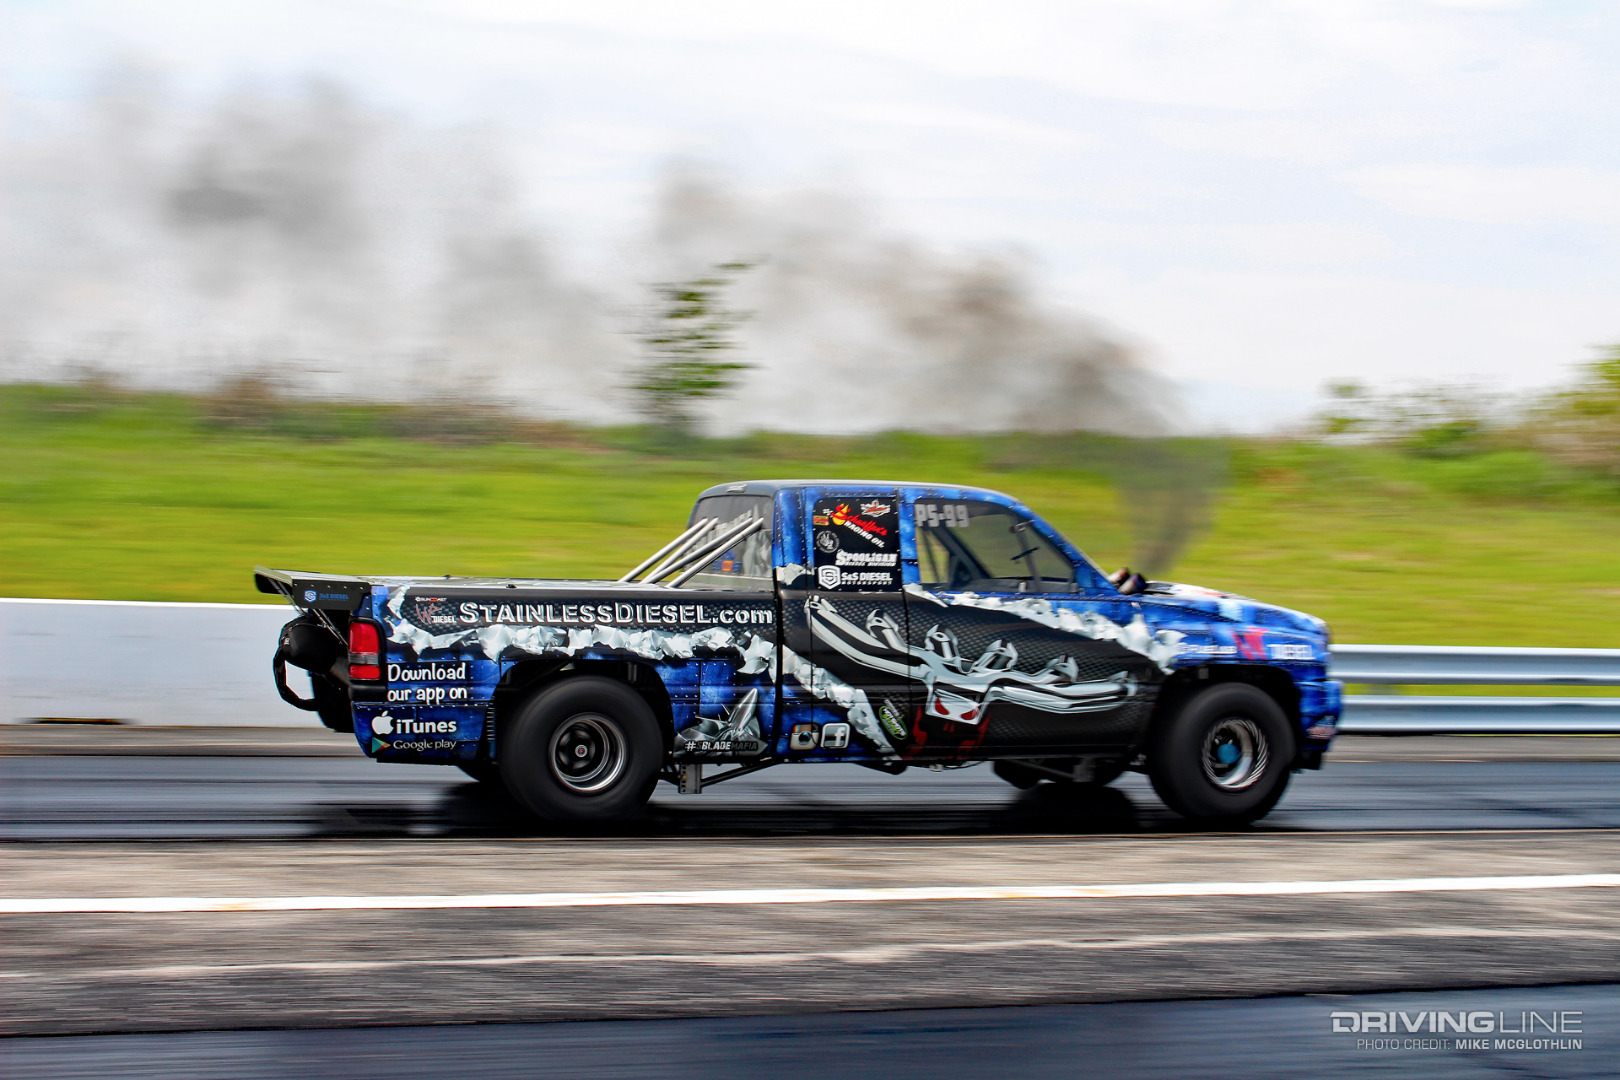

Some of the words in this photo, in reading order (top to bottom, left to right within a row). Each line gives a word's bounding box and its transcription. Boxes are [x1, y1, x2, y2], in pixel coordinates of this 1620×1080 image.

[843, 520, 874, 540] RACING
[871, 537, 885, 549] OIL
[841, 572, 859, 581] S&S
[860, 572, 893, 581] DIESEL
[430, 615, 457, 624] DIESEL
[459, 602, 773, 624] STAINLESSDIESEL.com
[387, 662, 466, 682] Download
[387, 688, 412, 702] our
[416, 687, 445, 705] app
[449, 687, 467, 699] on
[396, 719, 457, 734] iTunes
[393, 739, 433, 752] Google
[434, 739, 457, 750] play
